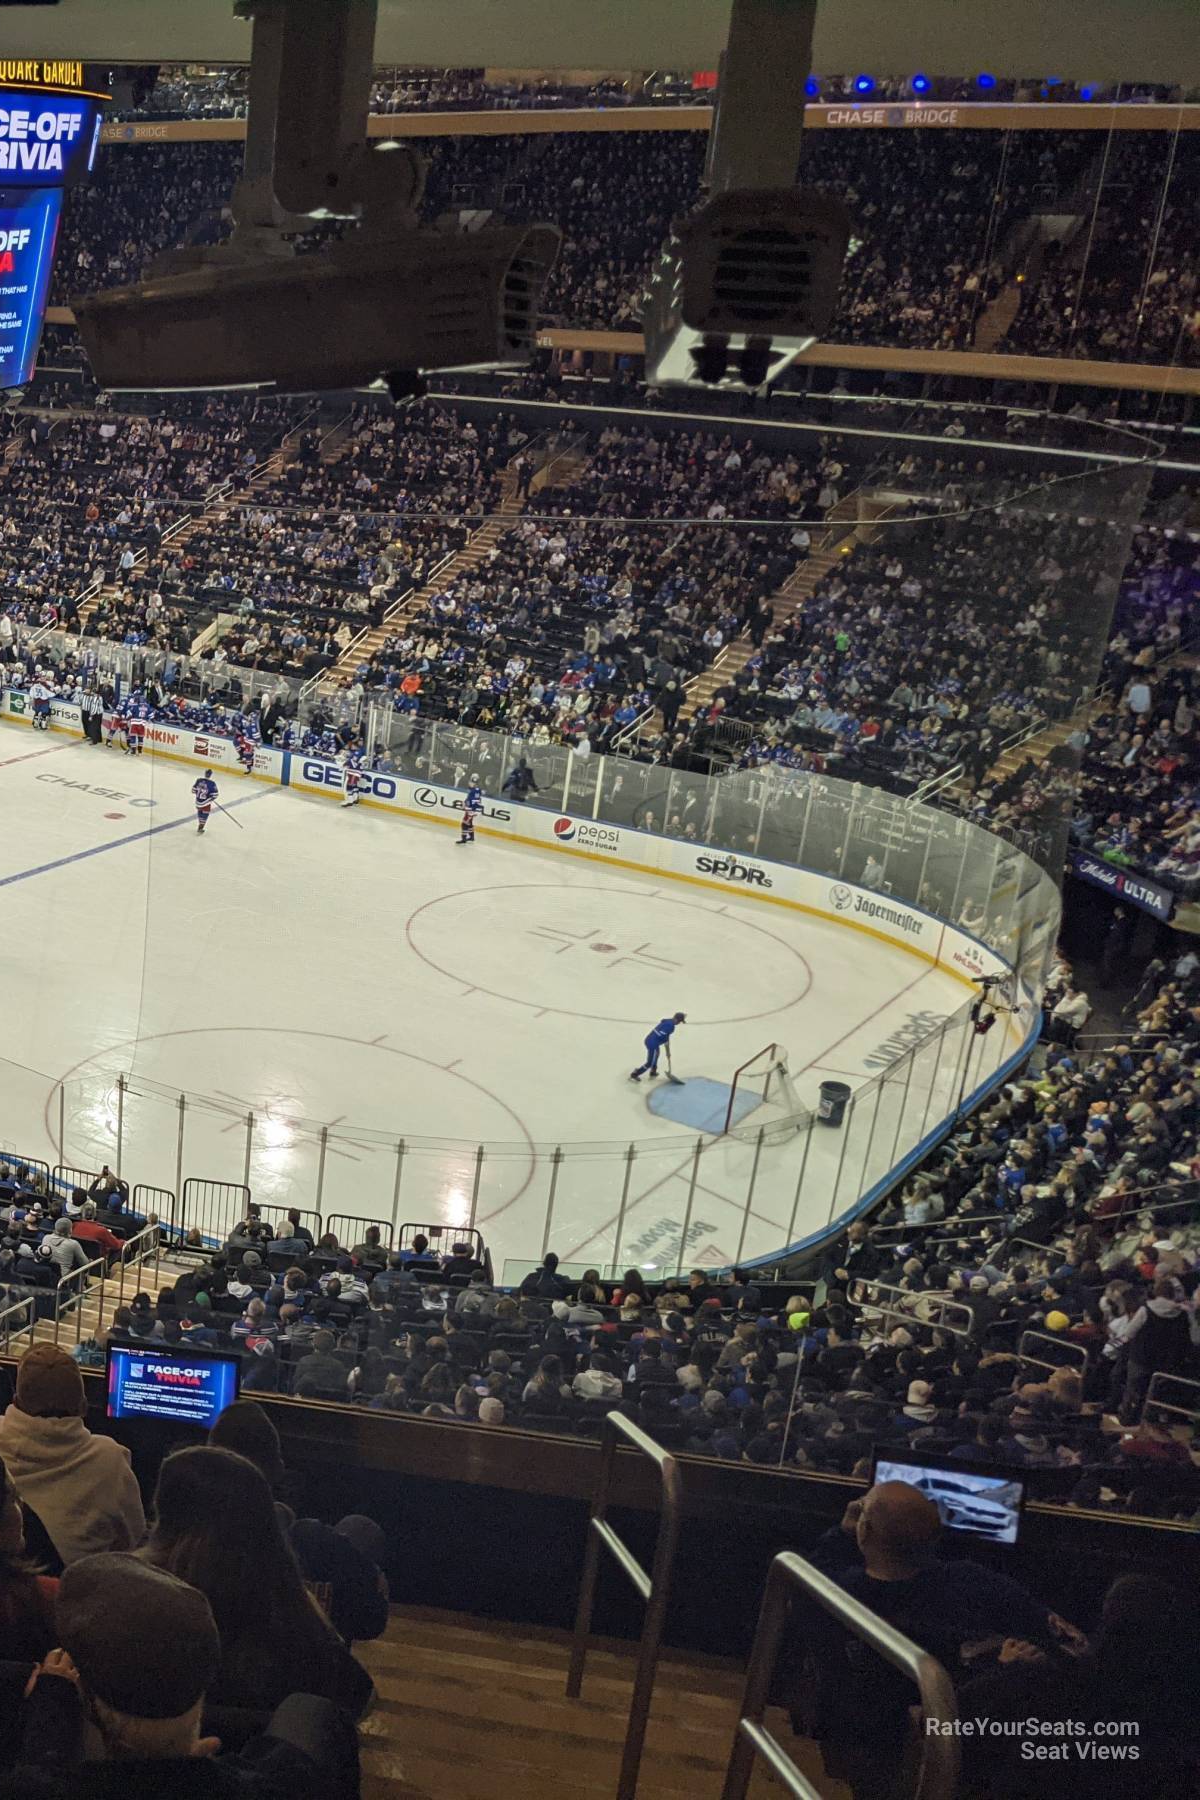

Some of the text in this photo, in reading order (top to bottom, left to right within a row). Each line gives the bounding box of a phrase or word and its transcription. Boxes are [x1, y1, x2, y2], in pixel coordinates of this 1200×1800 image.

[827, 109, 957, 124] CHASE BRIDGE
[102, 128, 167, 137] ASE BRIDGE
[146, 728, 179, 745] NKIN'
[34, 773, 130, 800] CHASE
[303, 761, 397, 799] GECO
[441, 796, 511, 822] LEUS
[578, 825, 620, 845] pepsi
[578, 839, 617, 851] ZERO SUGAR
[1124, 880, 1162, 909] ULTRA
[147, 1365, 211, 1378] FACE-OFF
[156, 1373, 201, 1385] TRIVIA
